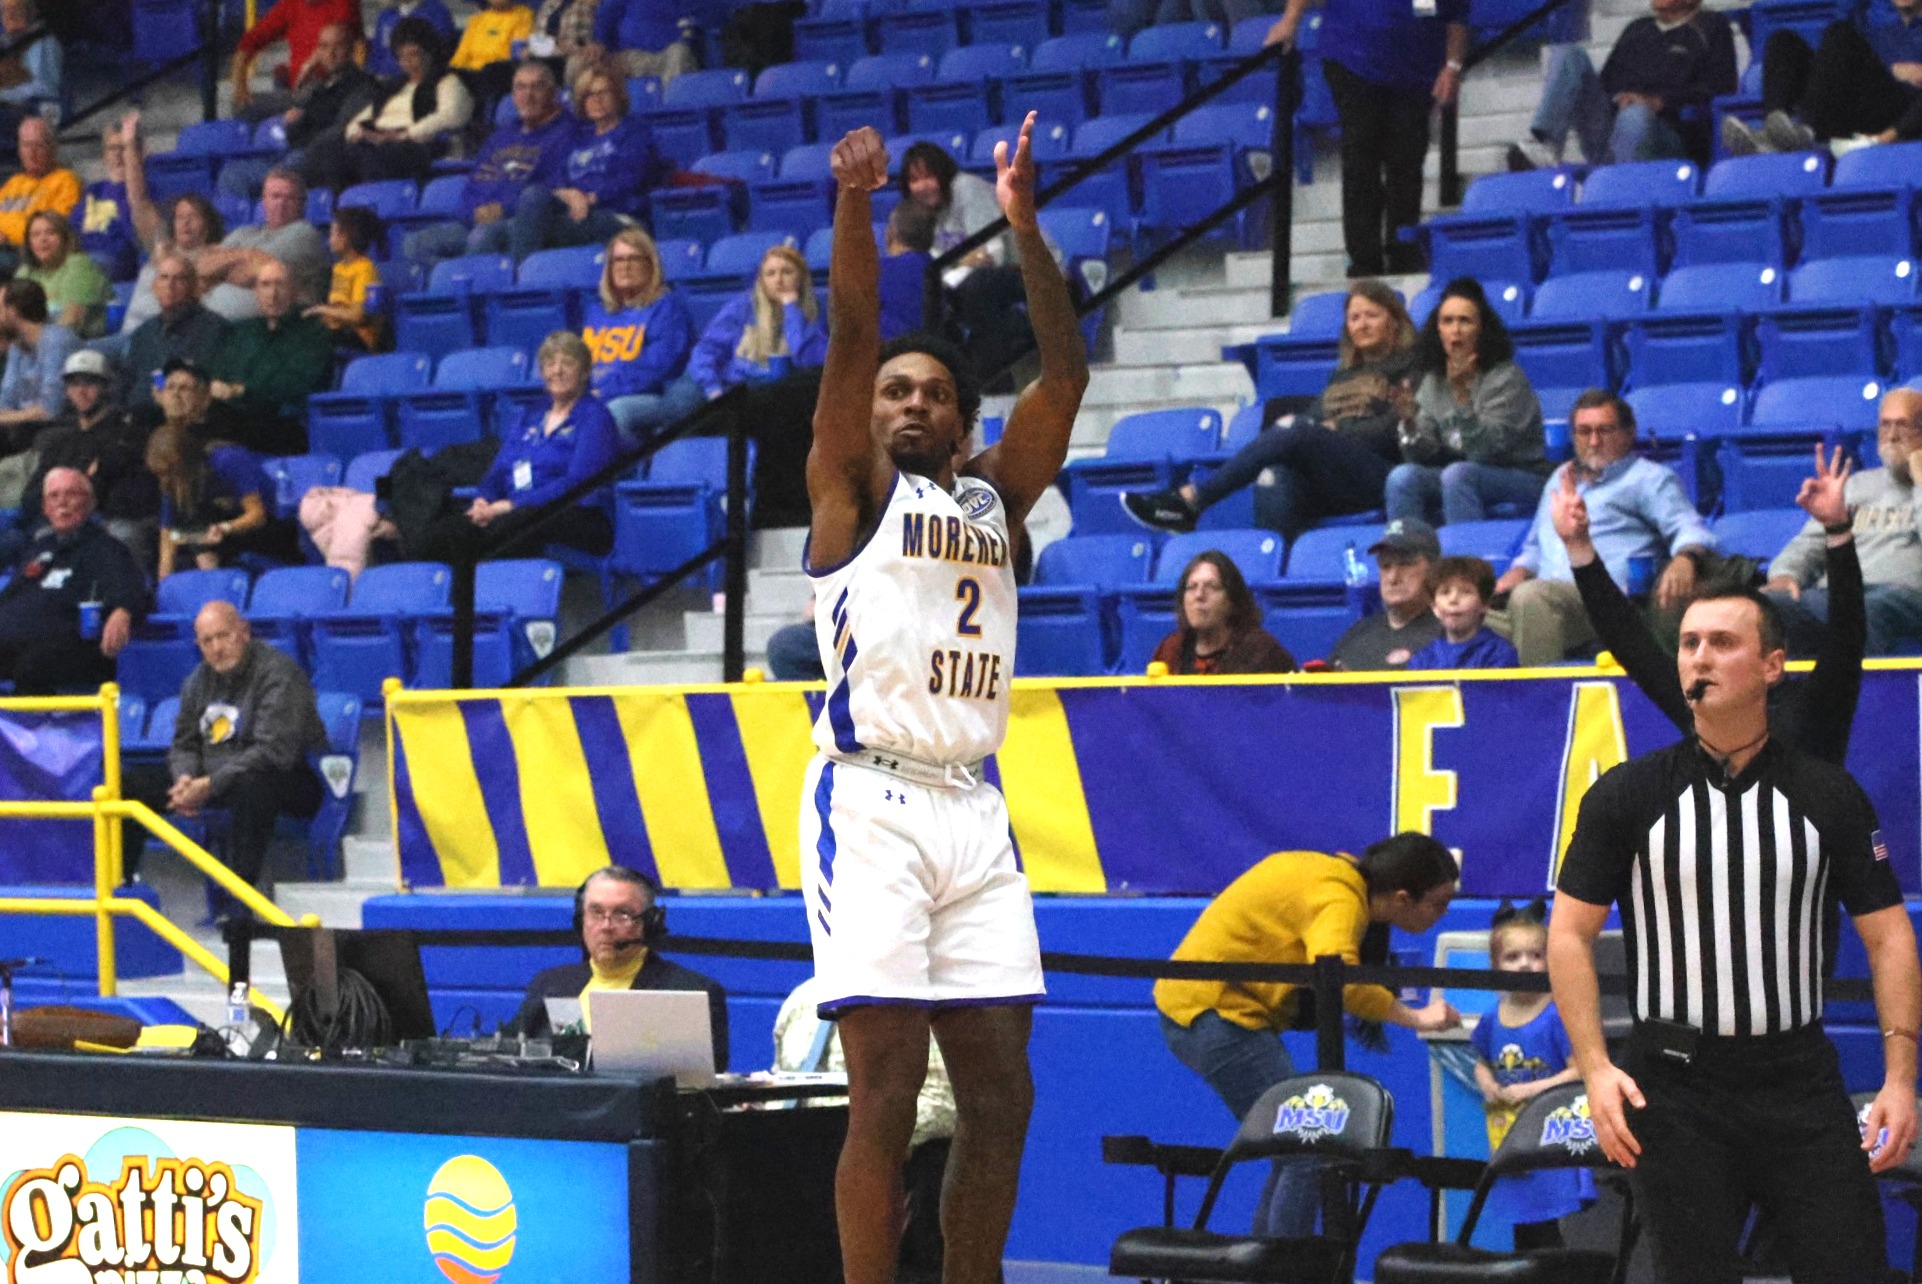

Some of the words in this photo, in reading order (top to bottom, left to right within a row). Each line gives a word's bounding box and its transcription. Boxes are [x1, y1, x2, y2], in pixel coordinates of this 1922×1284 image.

[582, 323, 647, 364] MSU
[955, 575, 983, 639] 2
[929, 649, 1001, 701] STATE
[1274, 1104, 1350, 1135] MSU
[1540, 1116, 1597, 1146] MS
